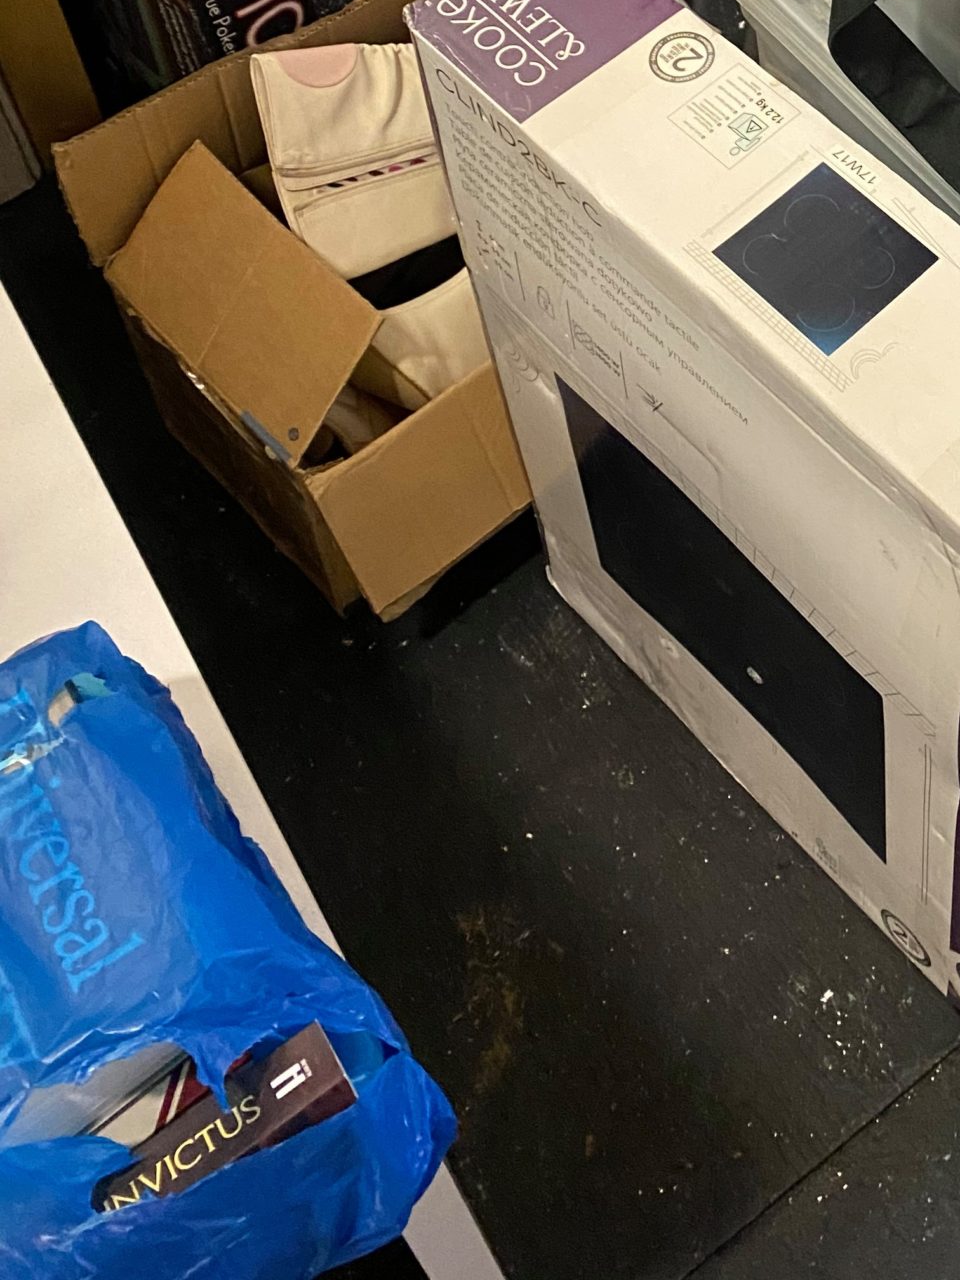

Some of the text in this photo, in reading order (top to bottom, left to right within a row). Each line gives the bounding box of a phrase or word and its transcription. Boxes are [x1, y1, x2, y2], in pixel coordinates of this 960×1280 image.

[555, 32, 585, 60] &
[752, 97, 770, 111] kg
[435, 64, 602, 229] CLIND2BK-C
[596, 264, 652, 326] dotykowo
[598, 251, 661, 319] commande
[663, 311, 699, 353] tactile
[666, 344, 748, 428] управлением
